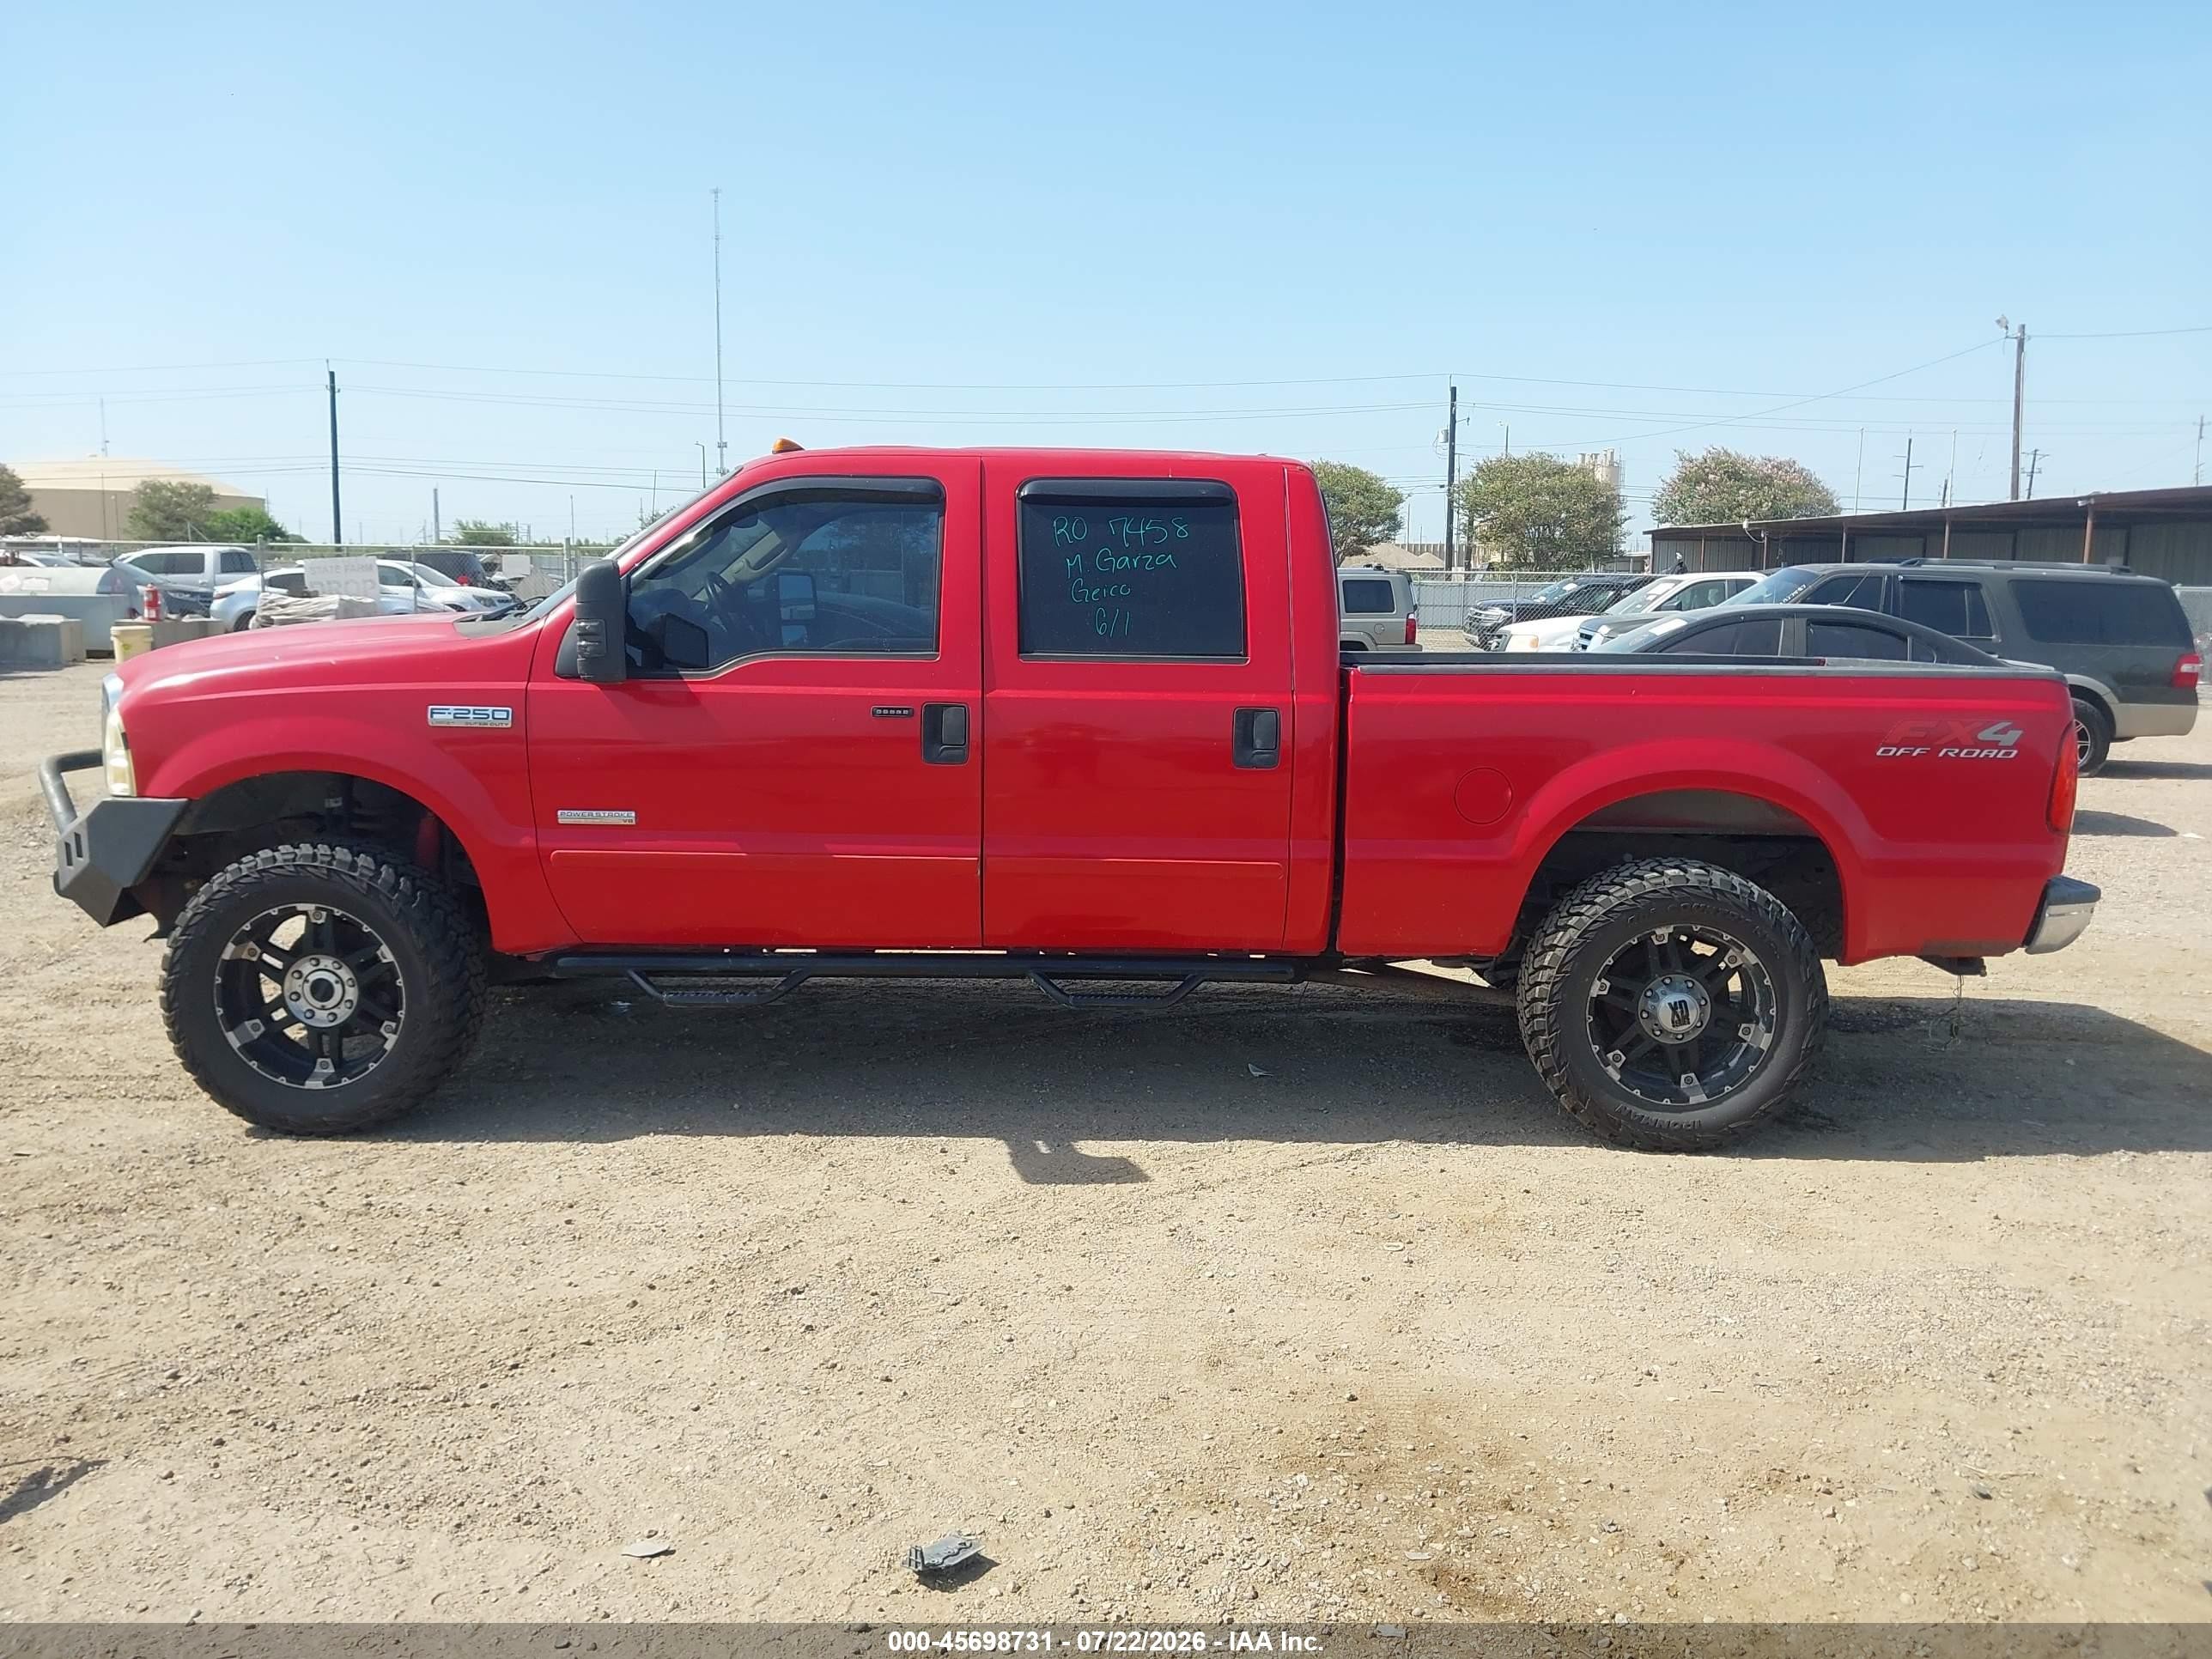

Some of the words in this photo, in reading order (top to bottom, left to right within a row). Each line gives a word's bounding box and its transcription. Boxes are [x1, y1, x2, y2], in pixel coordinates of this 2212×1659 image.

[1054, 516, 1087, 547] RO
[1109, 517, 1188, 547] 7458
[1096, 548, 1177, 574] Garza
[1072, 578, 1131, 603] Geico
[430, 707, 511, 720] F-250
[1881, 720, 2024, 746] FX4
[1875, 746, 1931, 757] OFF
[1937, 747, 2018, 759] ROAD
